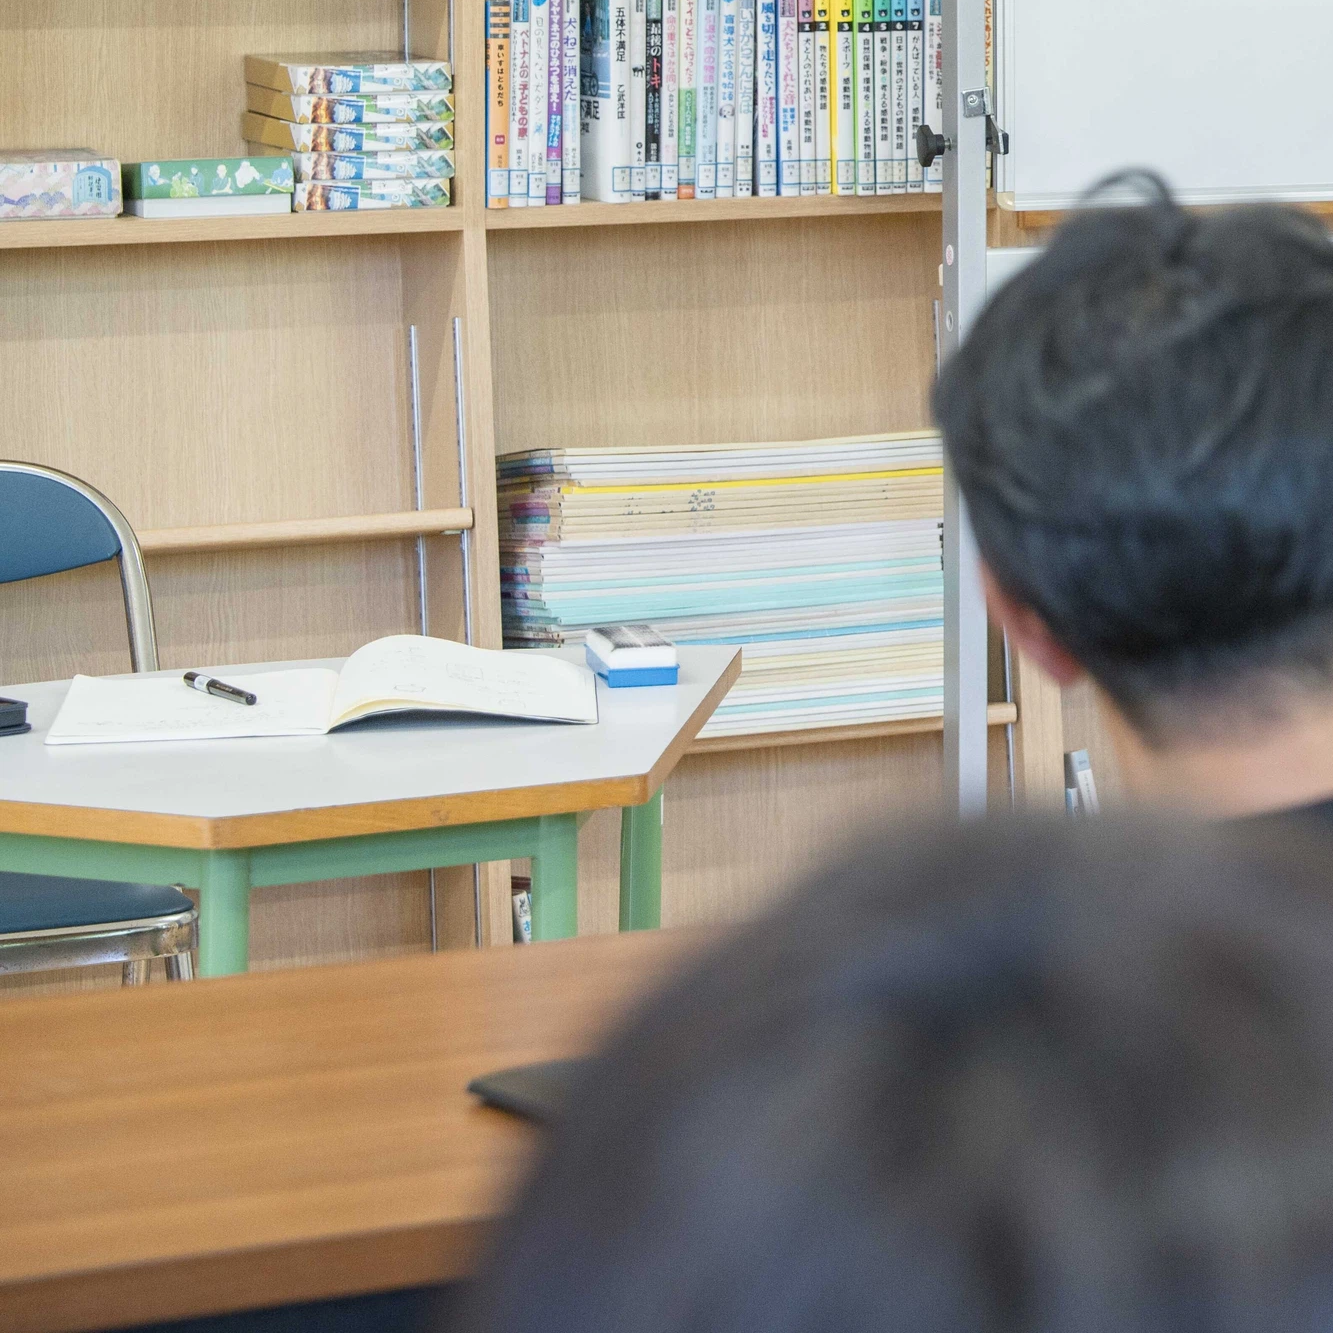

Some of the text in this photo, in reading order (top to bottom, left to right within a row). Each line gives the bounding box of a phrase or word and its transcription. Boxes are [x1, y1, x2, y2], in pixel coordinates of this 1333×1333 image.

[615, 6, 626, 62] 五体不満足
[760, 2, 775, 95] 風を切って走りたい!
[819, 22, 826, 30] 2
[842, 22, 849, 30] 3
[863, 23, 870, 31] 4
[880, 22, 887, 30] 5
[896, 22, 903, 30] 6
[563, 17, 578, 102] 犬やねこが消えた
[650, 22, 662, 89] 最後のトキ
[721, 14, 735, 101] 盲導犬不合格物語
[782, 20, 795, 105] 犬たちがくれた音
[617, 84, 626, 119] 乙武洋匡
